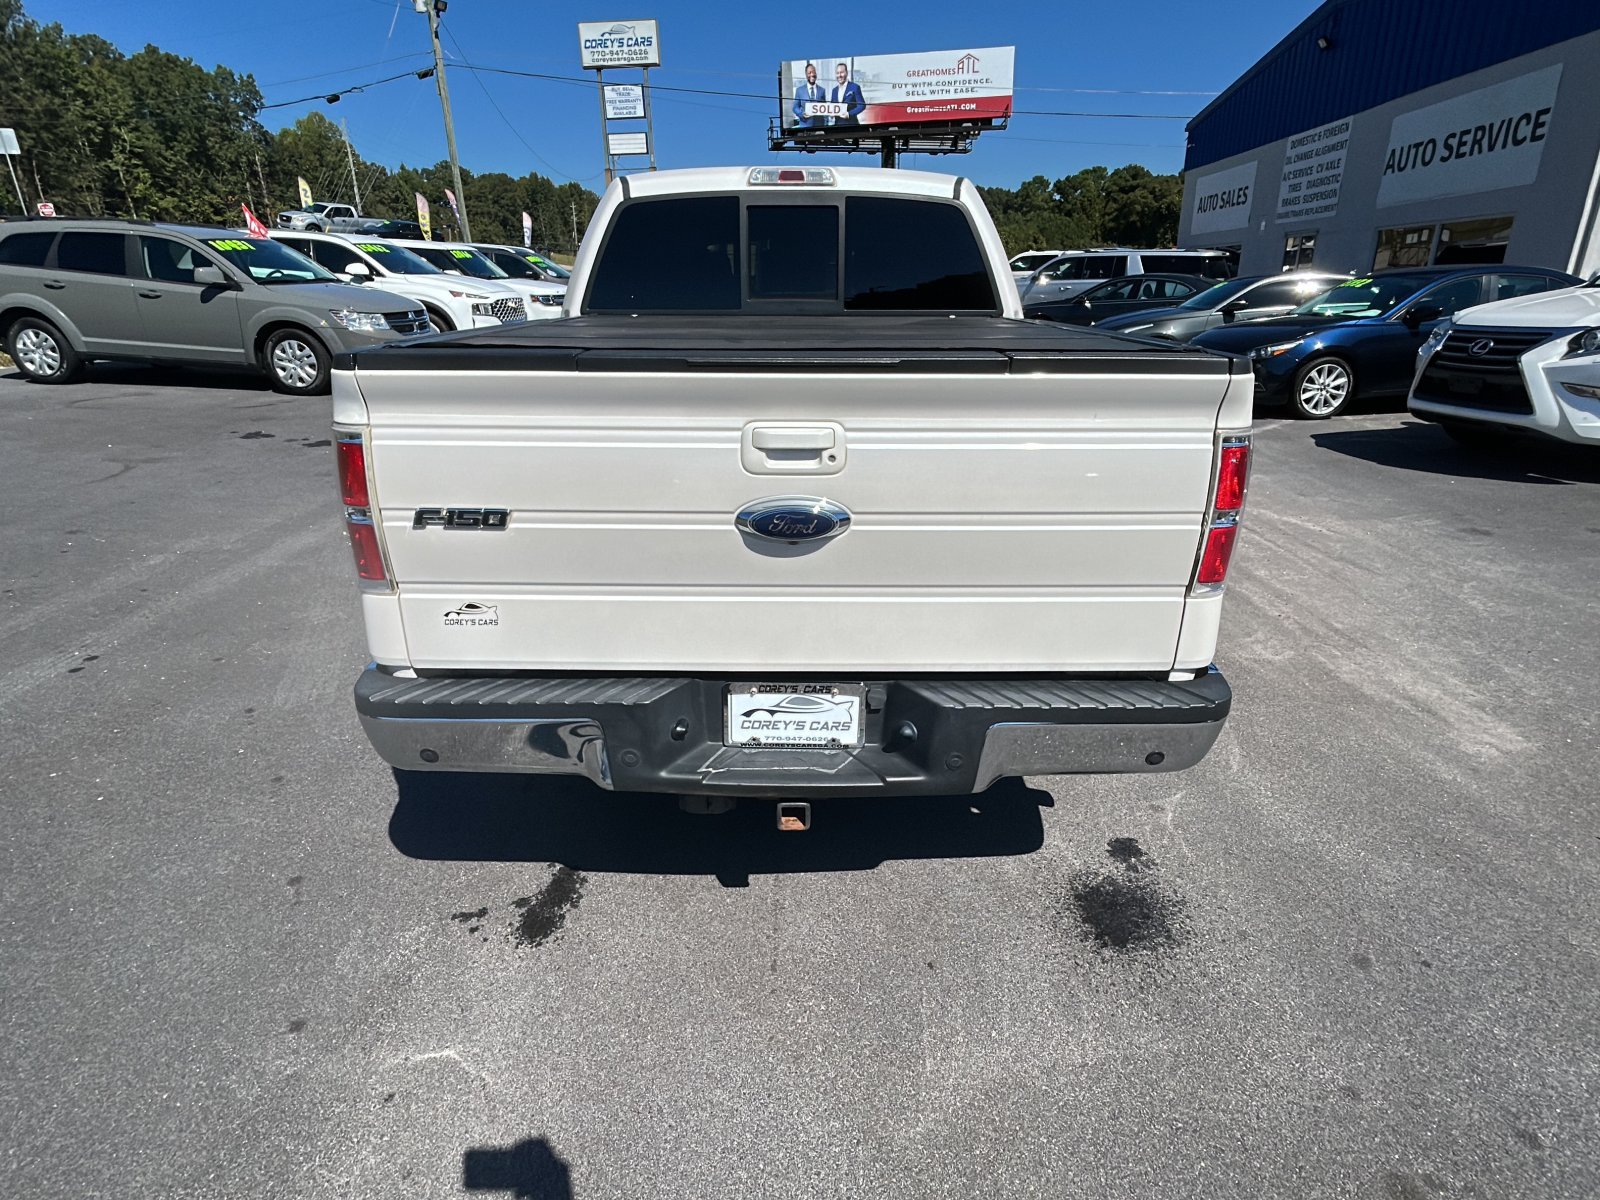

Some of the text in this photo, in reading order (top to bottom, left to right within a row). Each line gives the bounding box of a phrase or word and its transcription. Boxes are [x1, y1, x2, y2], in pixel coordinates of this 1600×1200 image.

[584, 36, 653, 49] COREY'S CARS
[590, 49, 649, 57] 770-947-0626
[906, 67, 956, 77] GREATHOMES
[935, 78, 993, 87] CONFIDENCE.
[812, 104, 841, 114] SOLD
[1291, 134, 1317, 149] DOMESTIC
[1324, 123, 1349, 138] FOREIGN
[1383, 107, 1552, 175] AUTO SERVICE
[1293, 149, 1315, 164] CHANGE
[1315, 139, 1348, 156] ALIGNMENT
[1325, 158, 1341, 170] AXLE
[1288, 174, 1341, 193] TIRES DIAGNOSTIC
[1197, 185, 1249, 214] AUTO SALES
[1282, 189, 1337, 207] BRAKES SUSPENSION
[768, 513, 818, 534] Ford
[444, 618, 499, 626] COREY'S CARS
[758, 684, 833, 694] COREY'S CARS
[740, 720, 853, 731] COREY'S CARS
